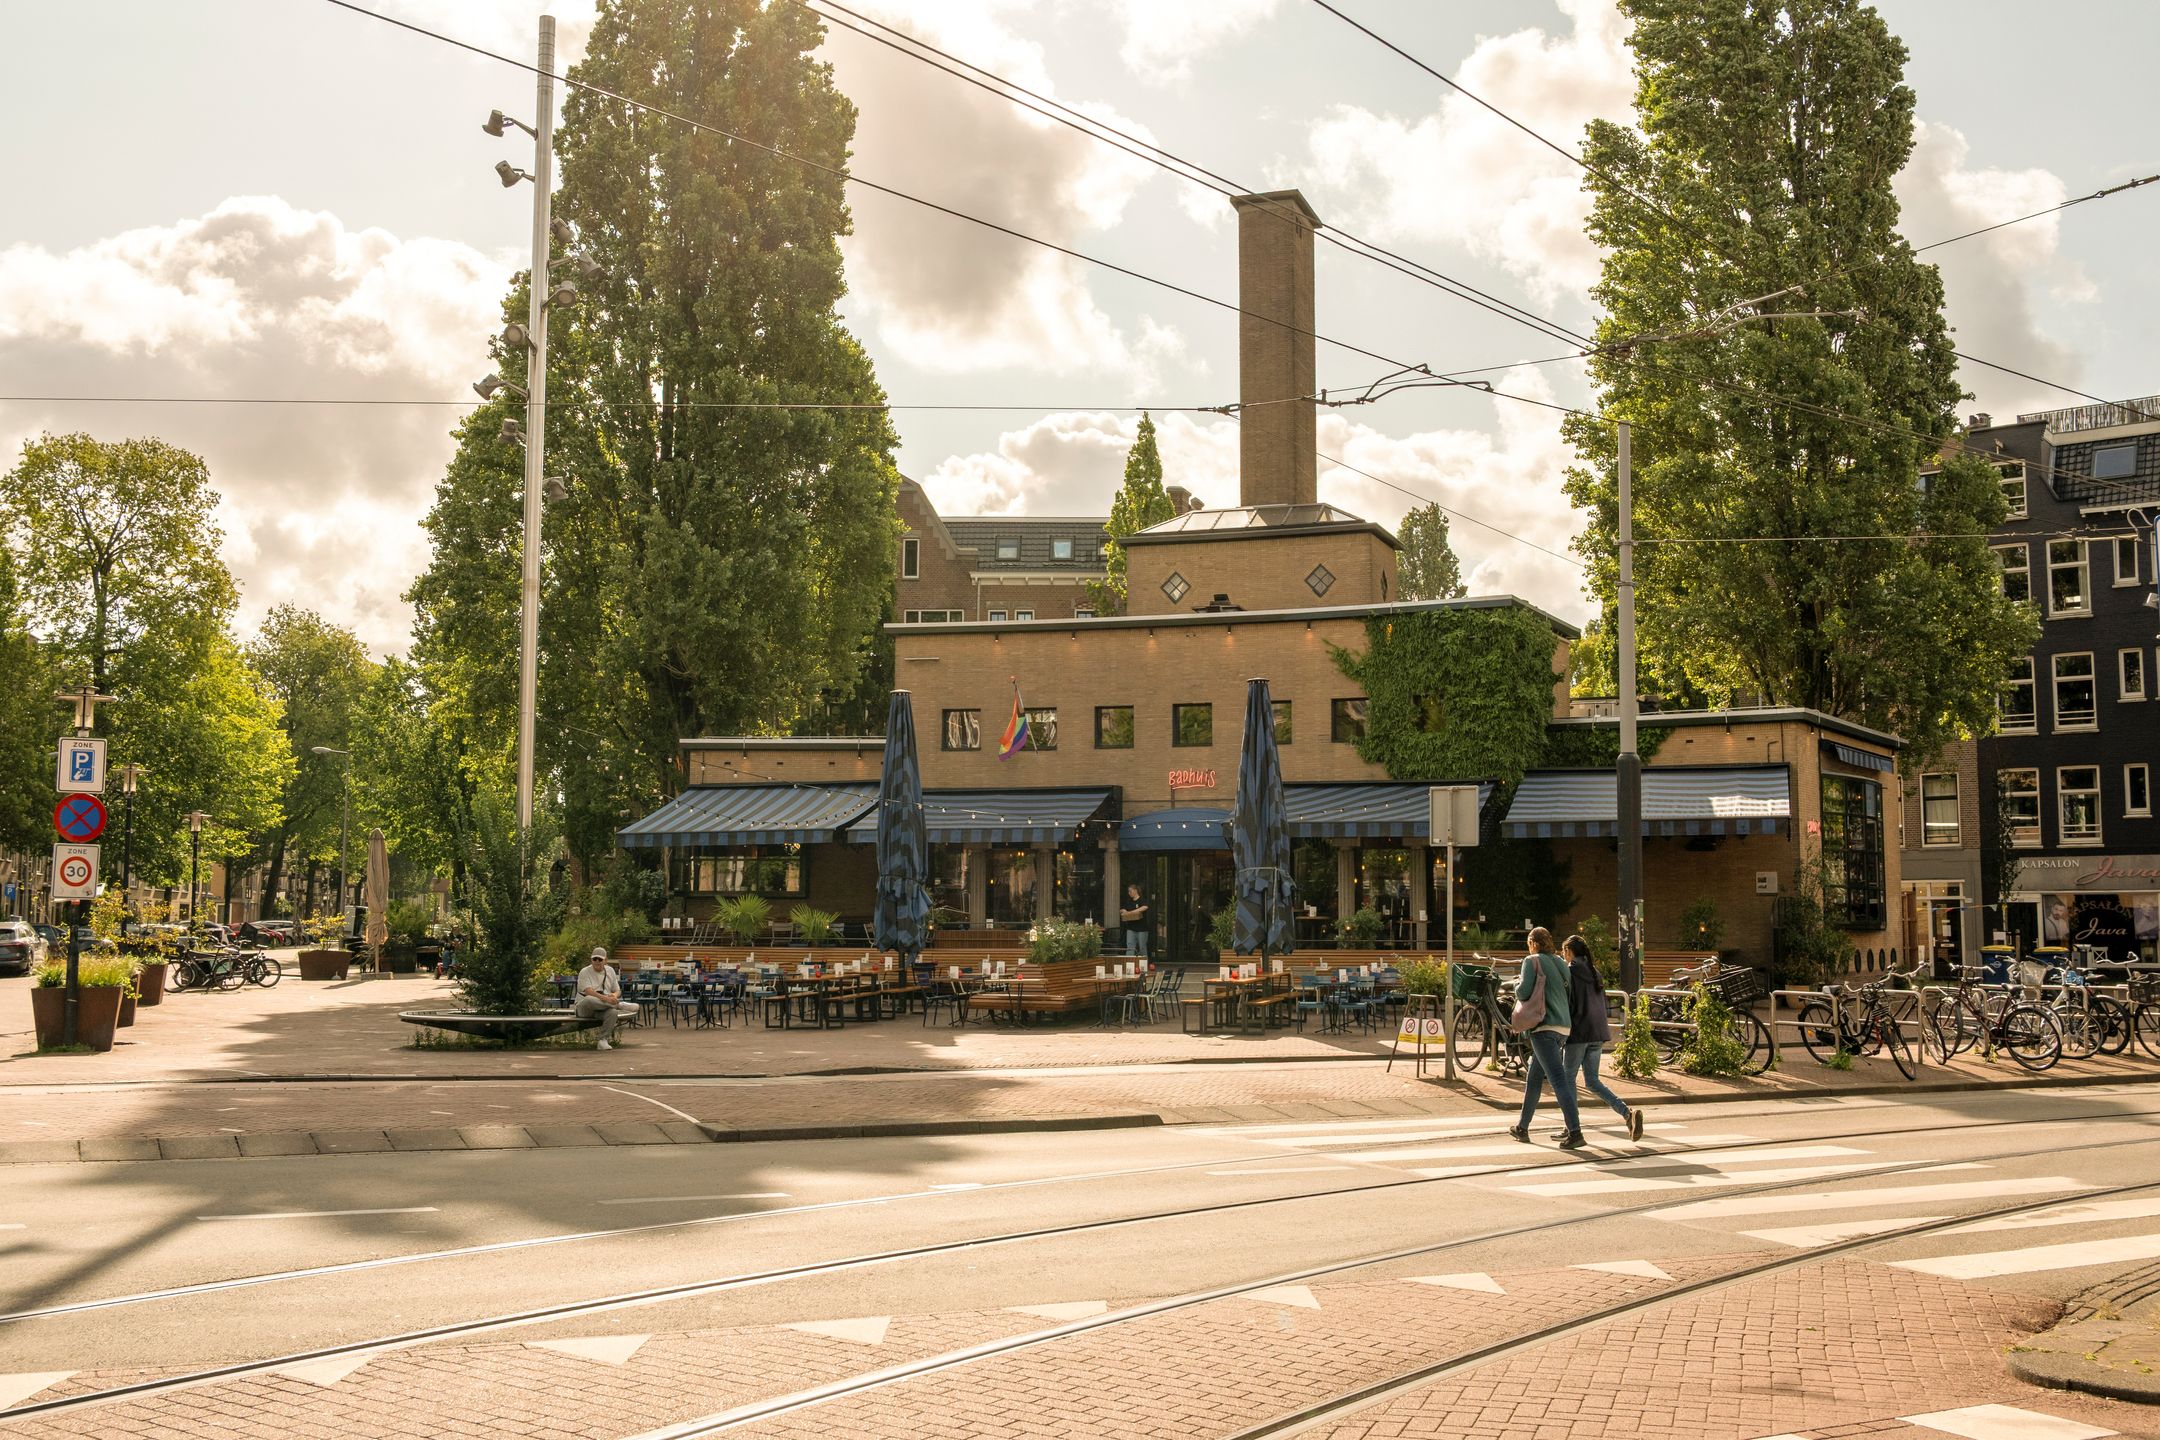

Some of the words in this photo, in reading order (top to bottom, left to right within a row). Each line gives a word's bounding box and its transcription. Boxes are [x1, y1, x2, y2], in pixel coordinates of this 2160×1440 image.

[76, 752, 89, 769] P
[2021, 859, 2080, 869] KAPSALON
[66, 866, 87, 878] 30
[2075, 917, 2128, 940] Java
